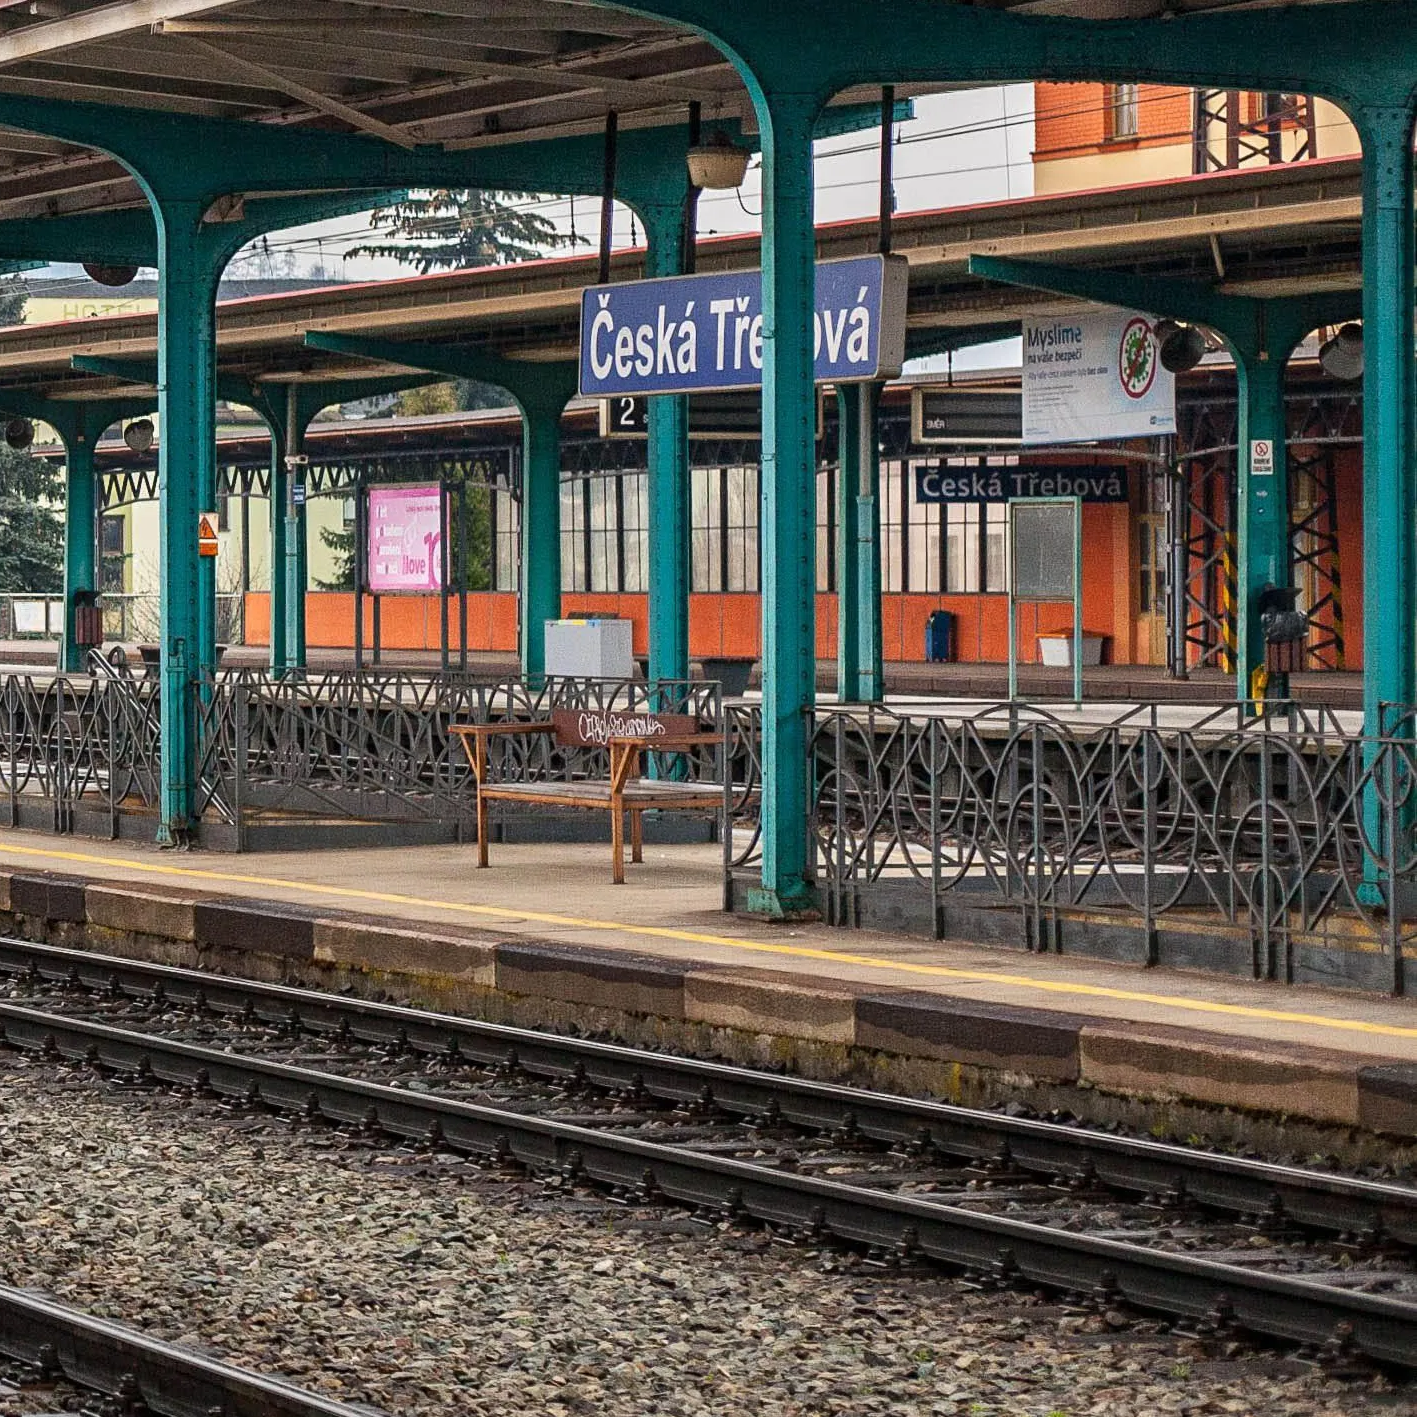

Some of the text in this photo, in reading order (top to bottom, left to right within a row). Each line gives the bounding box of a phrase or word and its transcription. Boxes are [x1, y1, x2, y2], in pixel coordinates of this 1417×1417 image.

[590, 285, 870, 381] Česká Třevá
[620, 397, 635, 425] 2
[922, 468, 1122, 498] Česká Třebová
